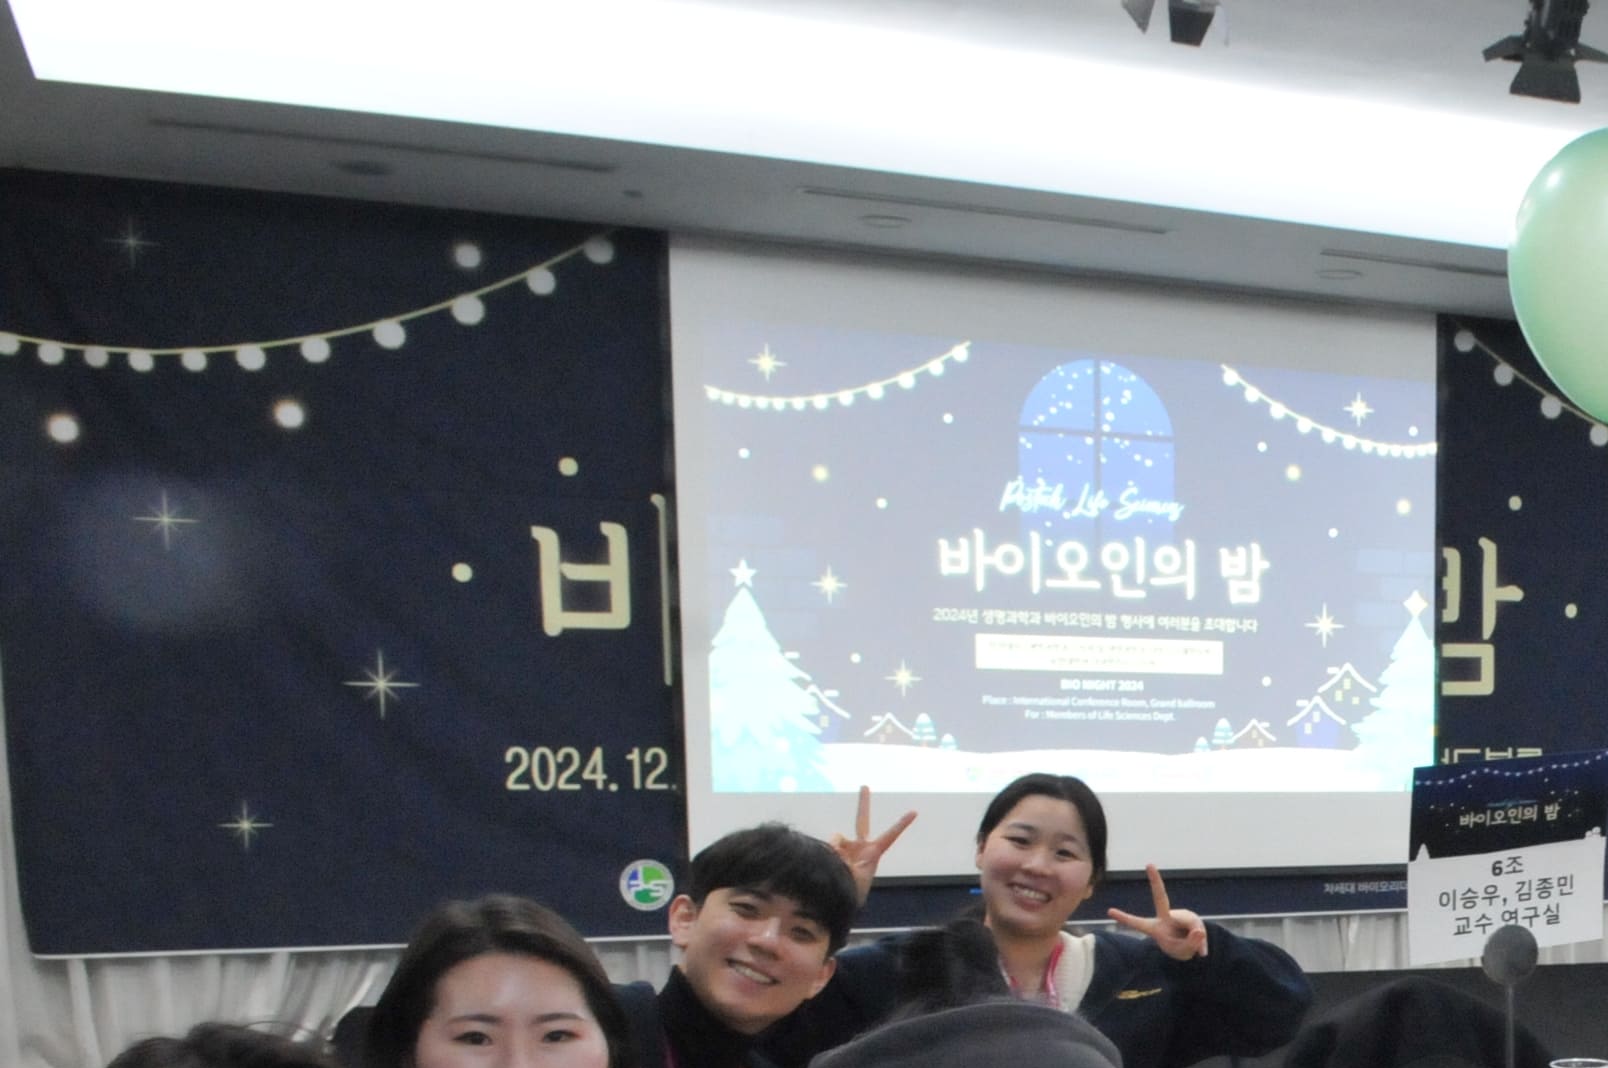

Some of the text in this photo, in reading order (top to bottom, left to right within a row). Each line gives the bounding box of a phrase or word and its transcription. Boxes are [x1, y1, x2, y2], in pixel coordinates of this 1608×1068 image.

[938, 527, 1271, 605] 바이오인의 밤
[932, 607, 979, 625] 2024년
[1044, 610, 1102, 629] 바이오인의
[1458, 801, 1560, 829] 바이오인의 밤
[1491, 856, 1524, 877] 6조
[1438, 873, 1575, 912] 이승우, 김종민
[1453, 913, 1494, 936] 교수
